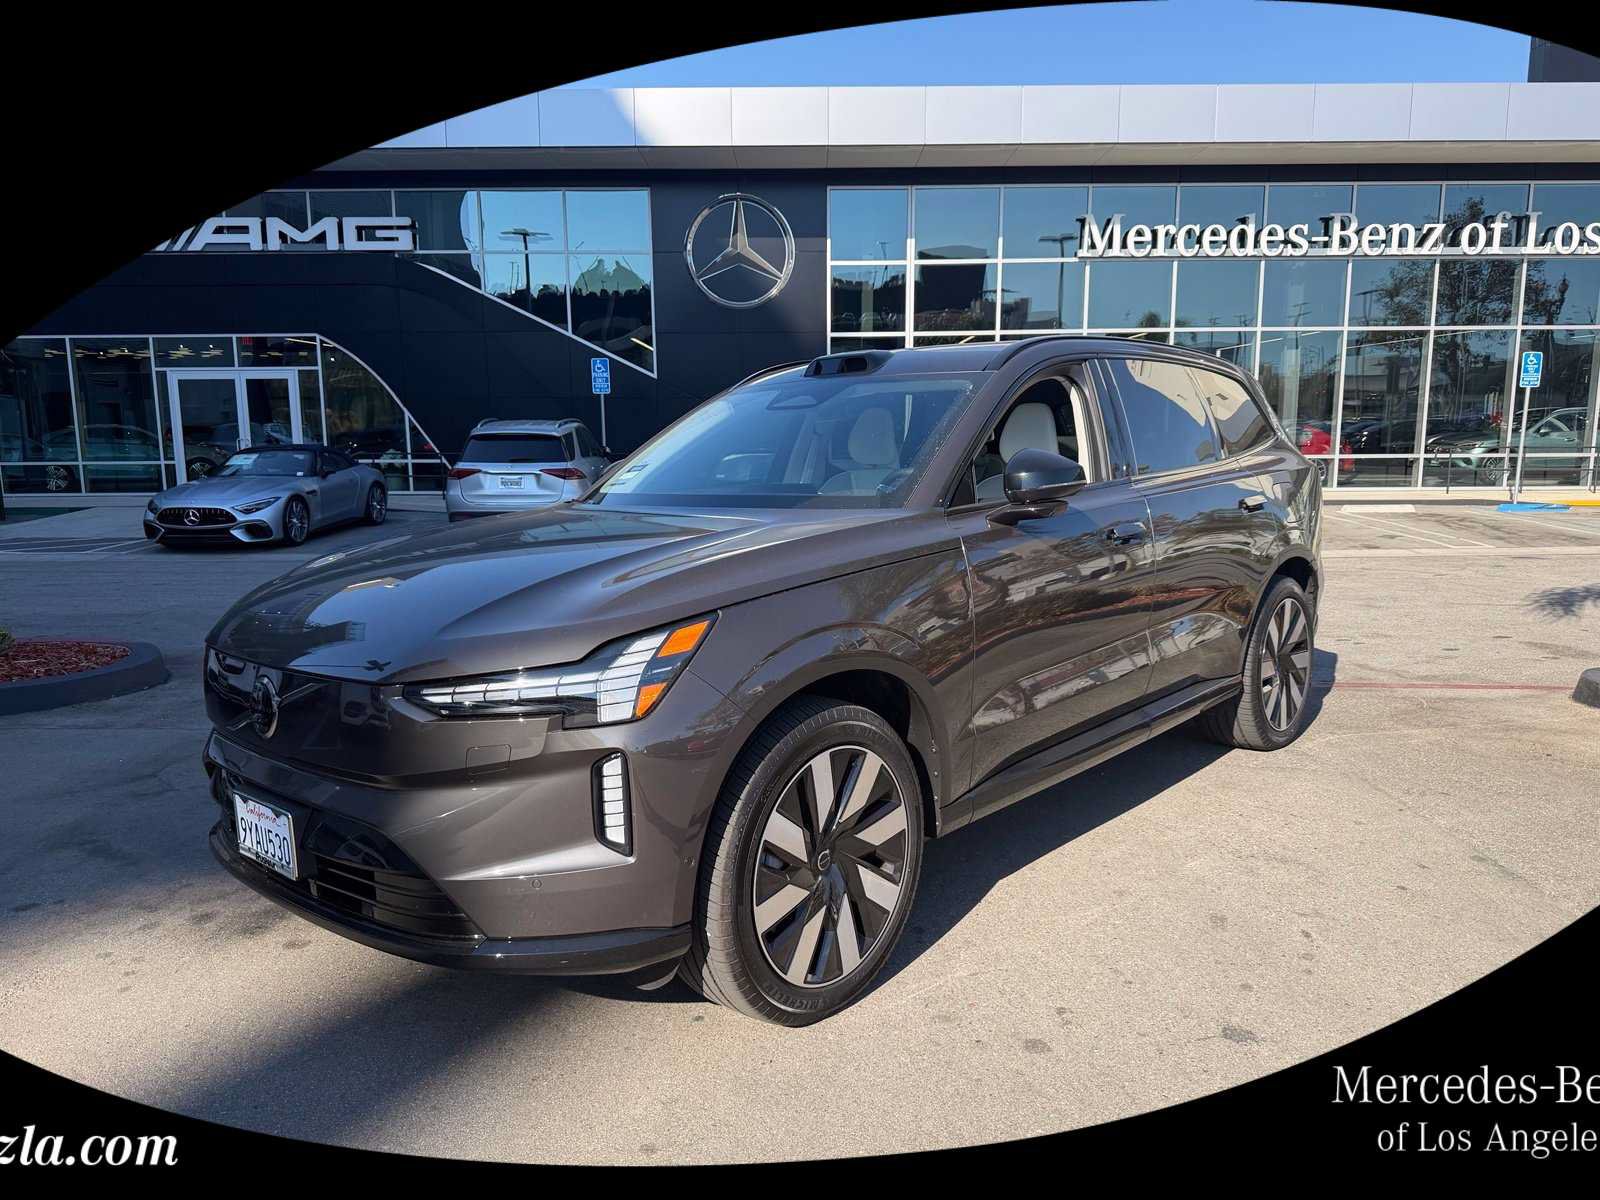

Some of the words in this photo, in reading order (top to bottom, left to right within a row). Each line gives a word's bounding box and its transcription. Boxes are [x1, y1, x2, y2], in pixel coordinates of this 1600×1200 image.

[189, 217, 414, 251] AMG
[1078, 212, 1447, 256] Mercedes-Benz
[1460, 211, 1511, 256] of
[1521, 211, 1600, 256] Los
[240, 816, 292, 867] 9YAU530
